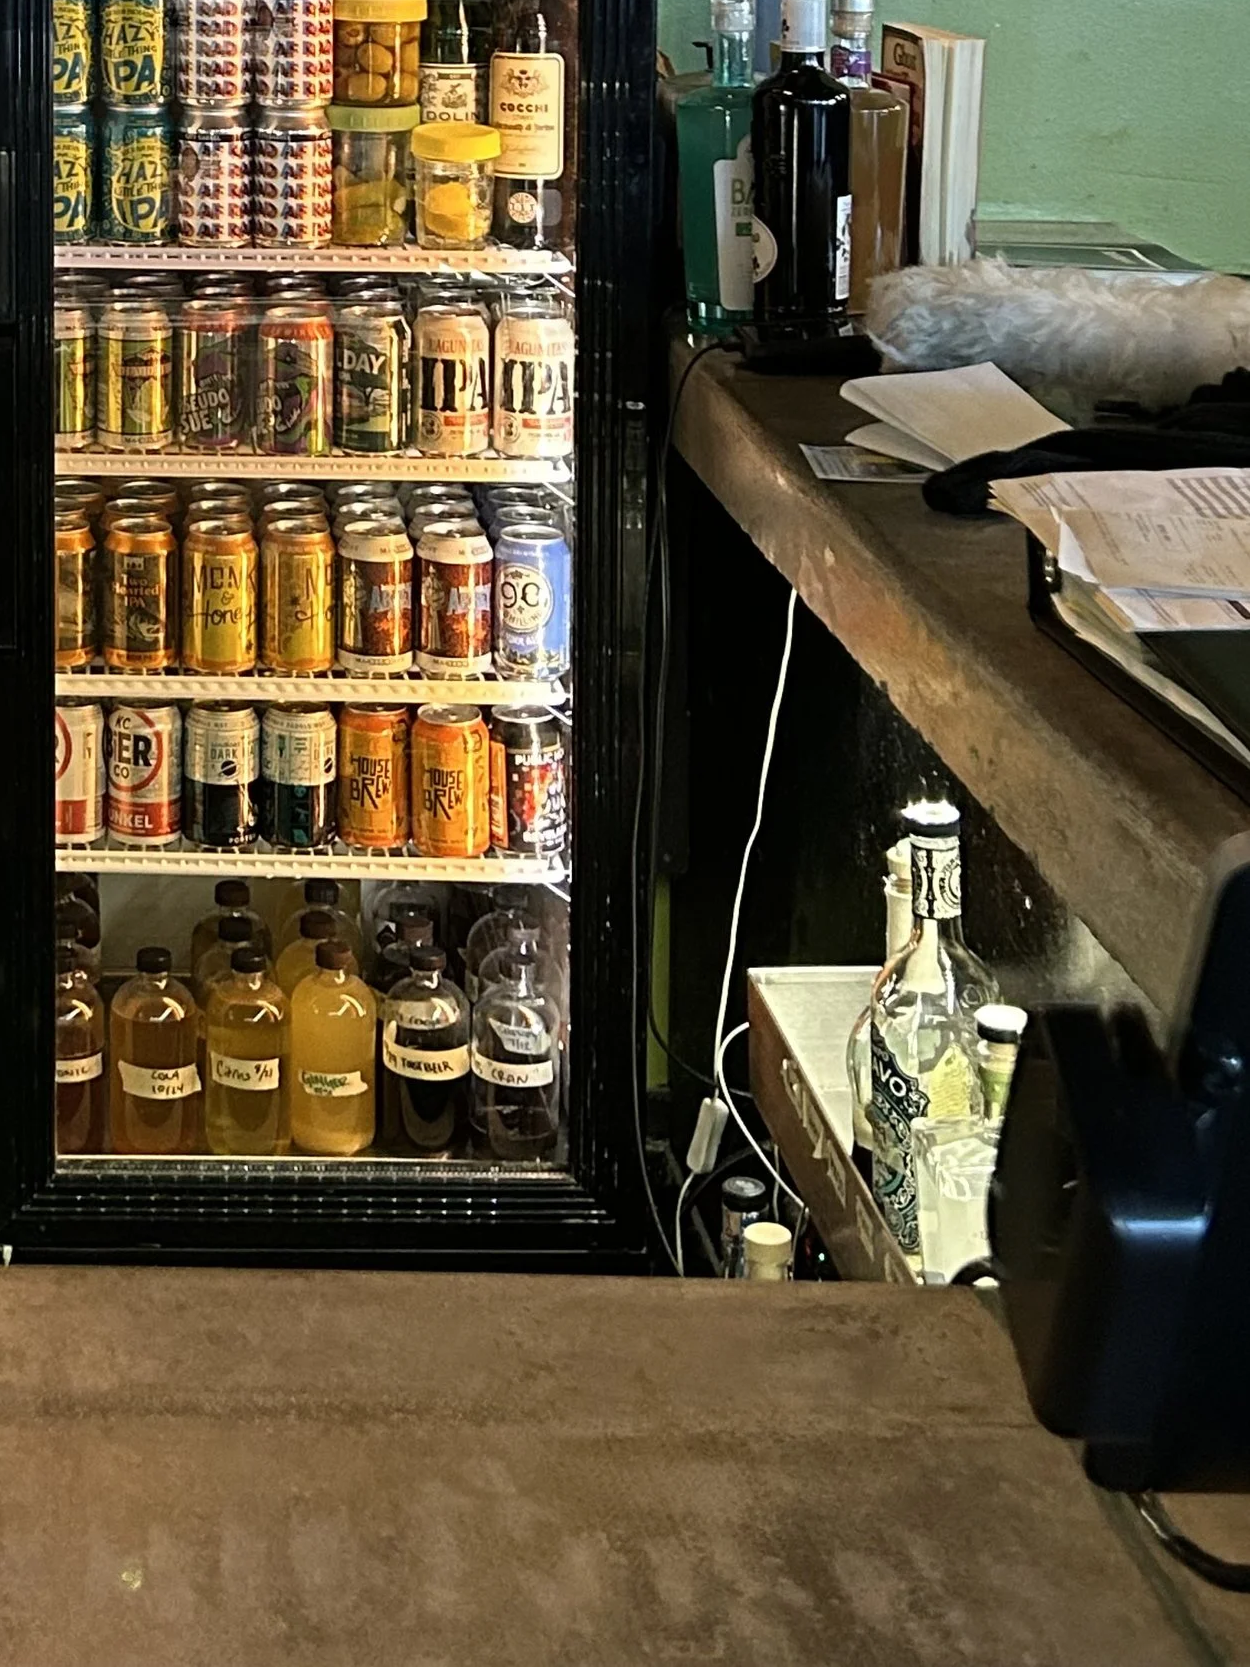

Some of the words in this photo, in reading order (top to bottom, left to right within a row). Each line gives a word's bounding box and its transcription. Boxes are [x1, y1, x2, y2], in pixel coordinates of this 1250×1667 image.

[53, 57, 85, 90] PA
[426, 110, 481, 122] DOLIN
[500, 102, 549, 113] COCCHI
[420, 356, 489, 413] IPA
[500, 357, 572, 416] IPA
[121, 573, 149, 587] Two
[123, 596, 147, 609] IPA
[114, 715, 131, 730] KC
[209, 747, 238, 760] DARK
[113, 764, 130, 780] CO
[351, 757, 391, 778] HOUSE
[425, 769, 465, 790] HOUSE
[350, 775, 392, 810] BREW
[424, 787, 465, 821] BREW
